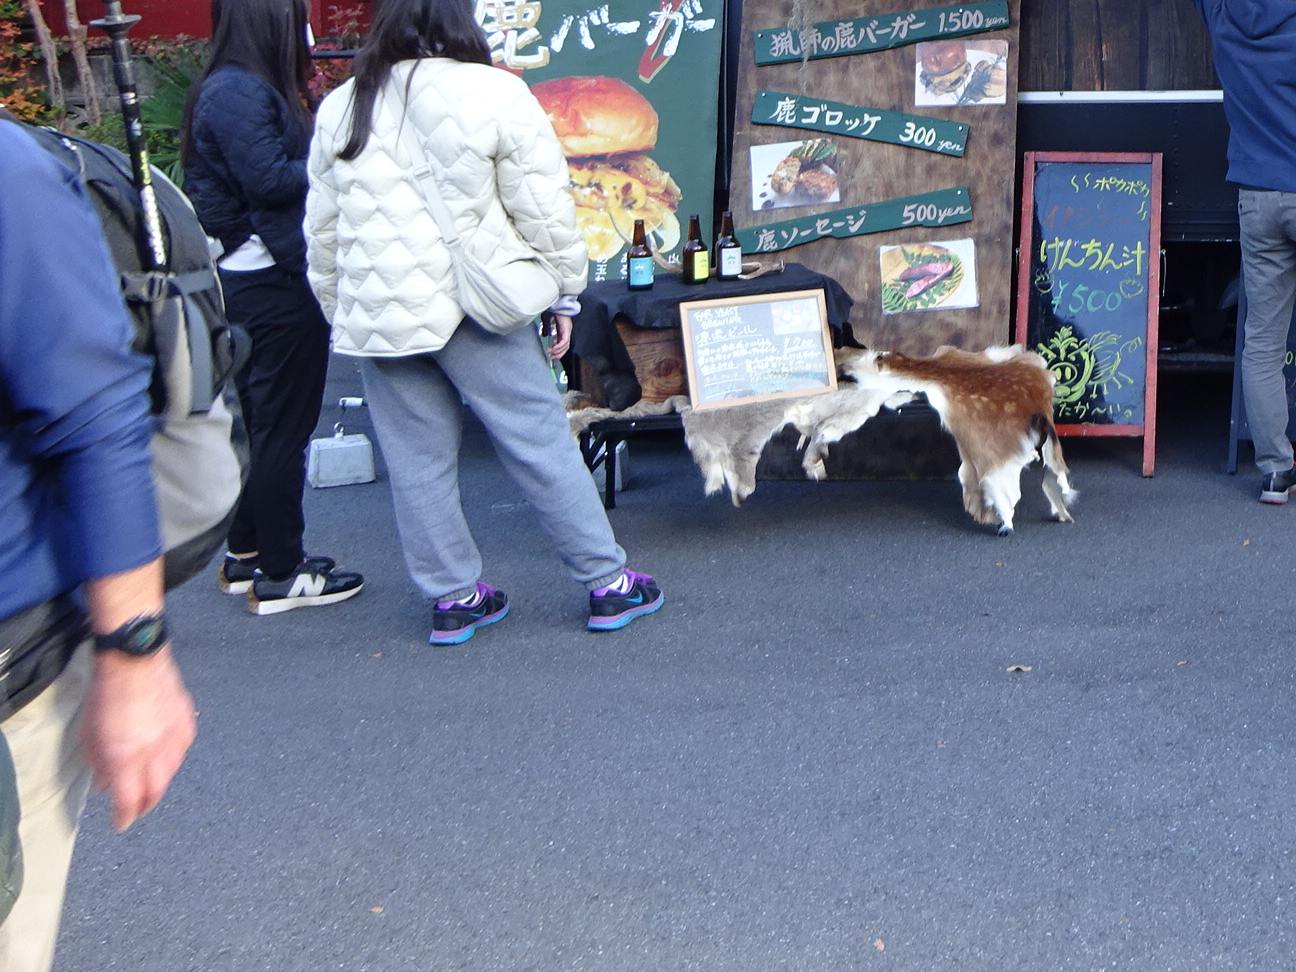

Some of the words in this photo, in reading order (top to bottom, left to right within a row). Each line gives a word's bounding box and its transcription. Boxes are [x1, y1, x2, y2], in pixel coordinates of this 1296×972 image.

[899, 122, 936, 147] 300
[938, 139, 963, 152] yen
[1093, 176, 1150, 198] ポカポカ
[754, 210, 867, 252] 鹿ソーセージ
[902, 204, 937, 225] 500
[936, 206, 971, 223] yen
[1040, 236, 1146, 276] けんちん汁
[693, 308, 713, 322] FAR
[701, 316, 742, 329] BREWING
